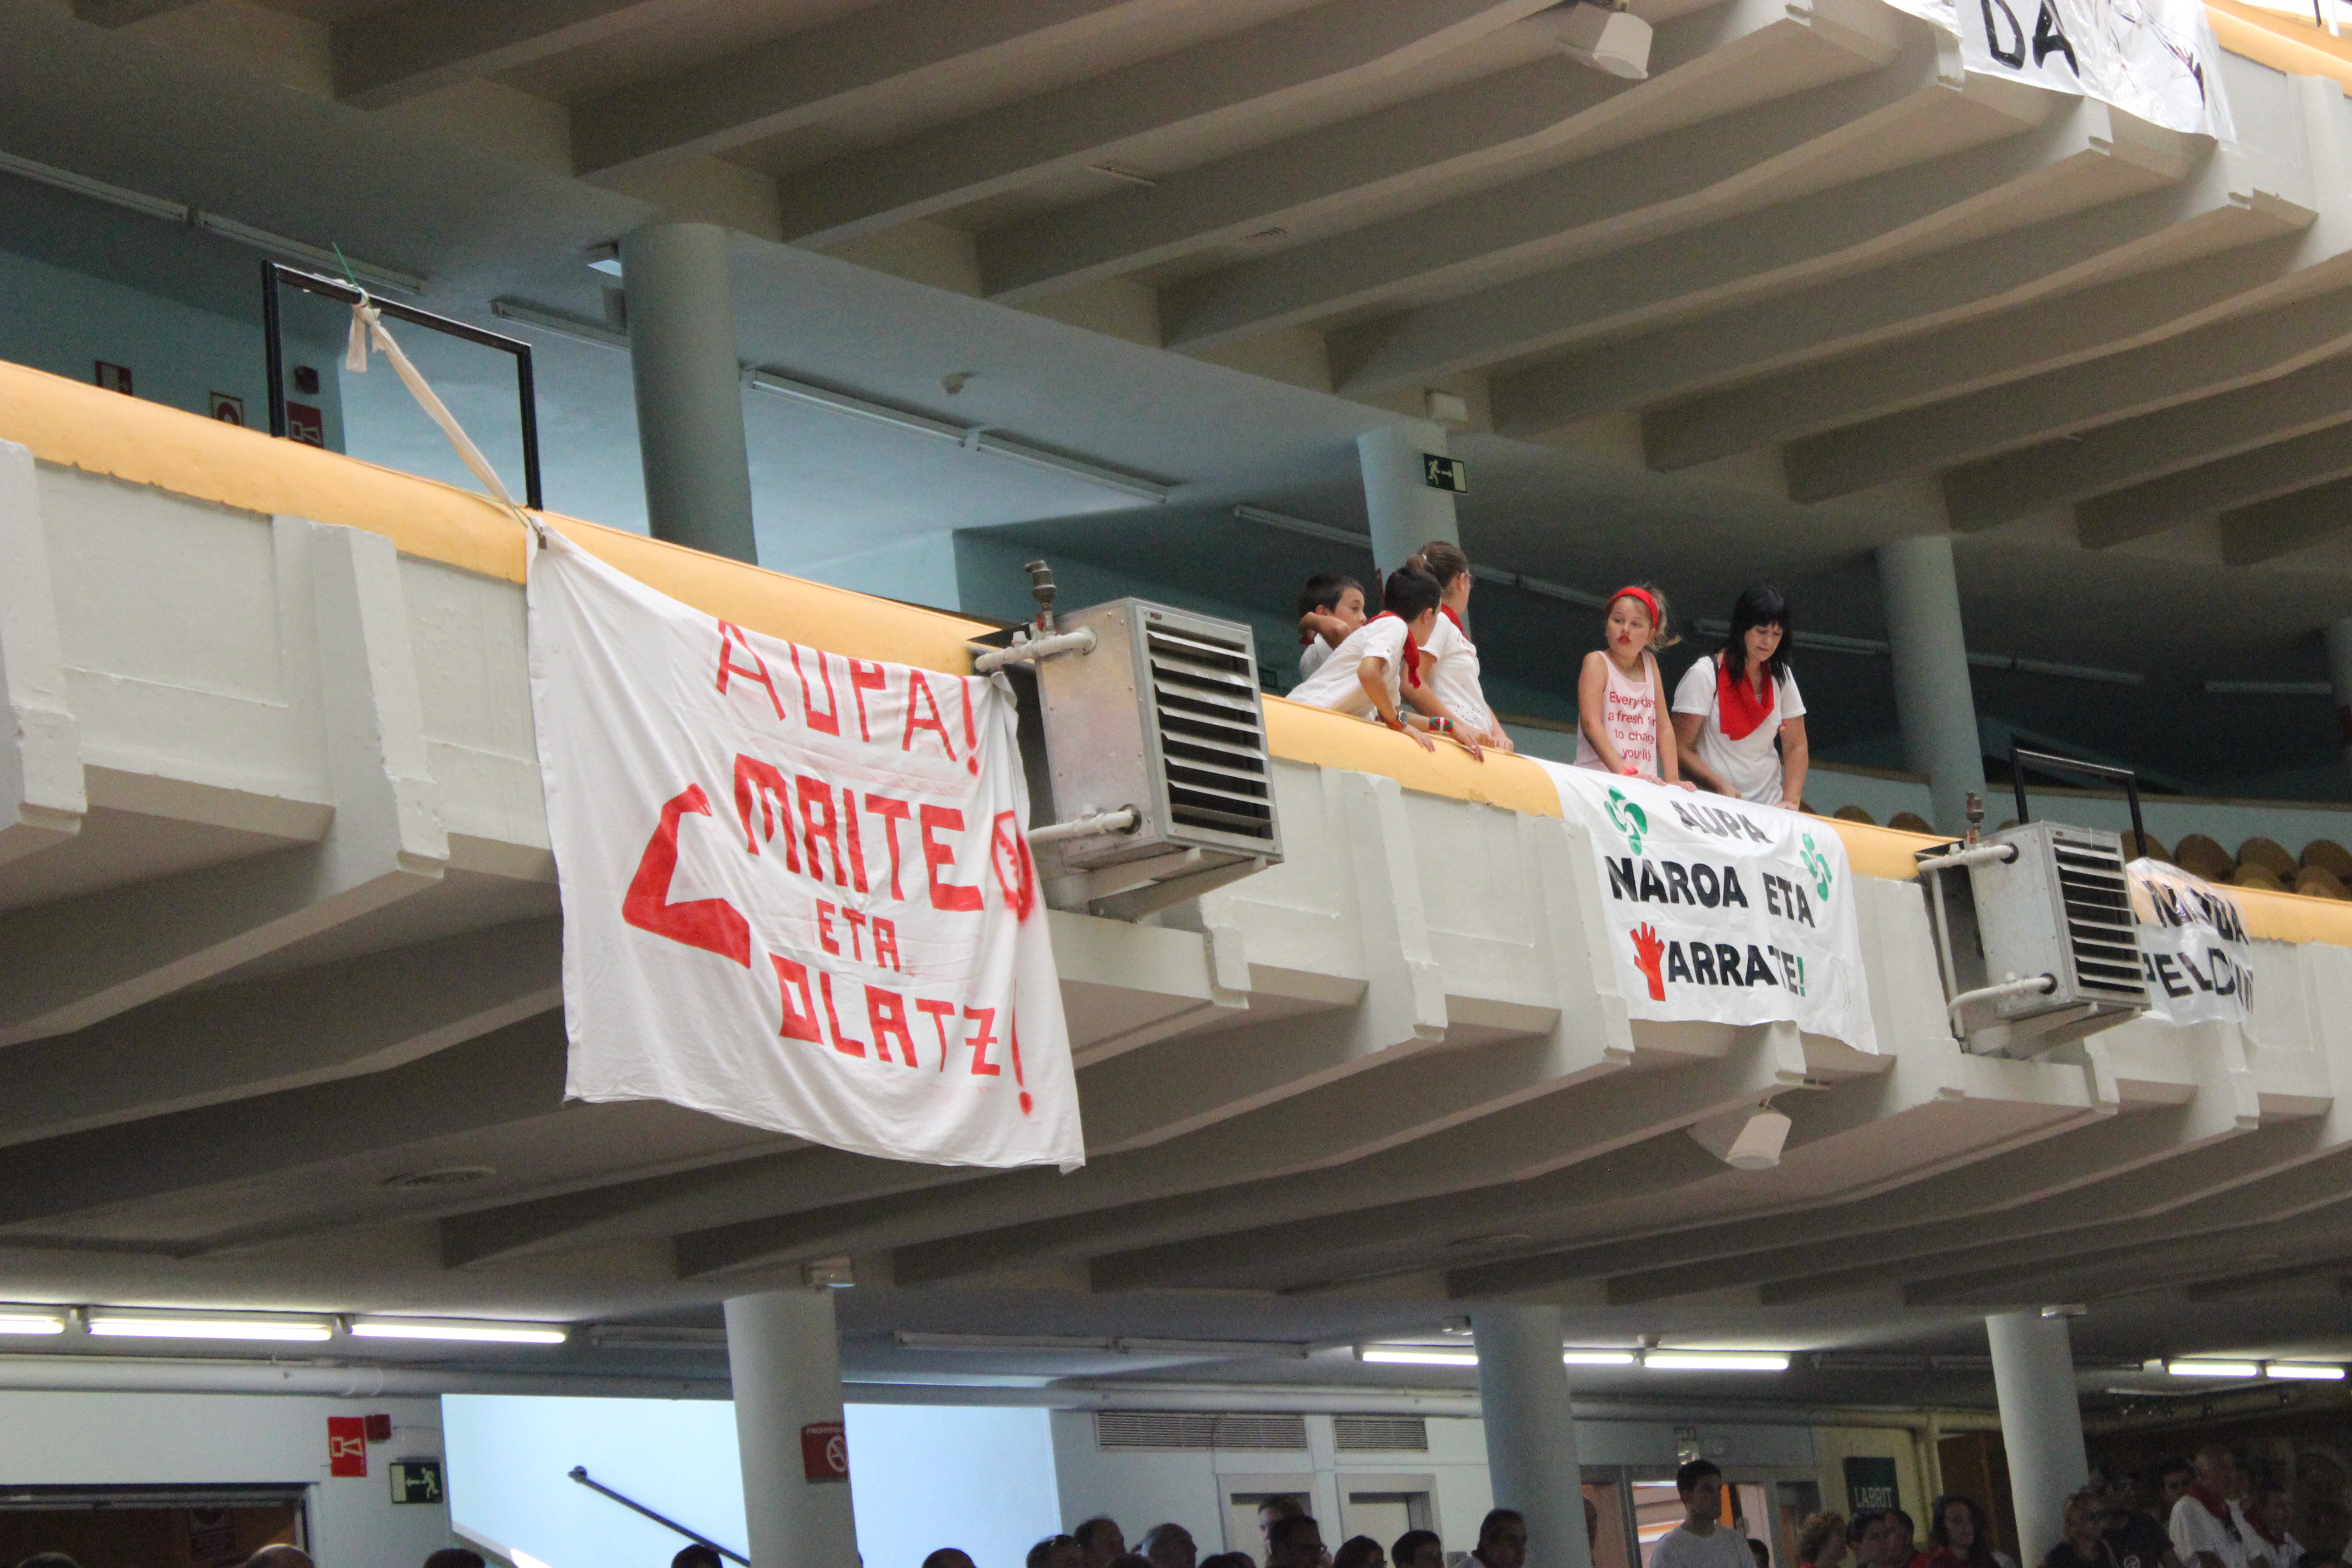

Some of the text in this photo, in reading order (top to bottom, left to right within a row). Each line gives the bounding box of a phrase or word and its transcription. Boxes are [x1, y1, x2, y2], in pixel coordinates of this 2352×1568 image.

[715, 619, 978, 778] AUPA!
[1608, 712, 1615, 721] a
[1616, 710, 1644, 725] fresh
[1609, 691, 1640, 709] Every
[1614, 728, 1624, 740] to
[734, 752, 984, 912] MAITE
[1670, 799, 1776, 844] AUPA
[1603, 855, 1816, 929] NAROA ETA
[815, 897, 901, 972] ETA
[1668, 941, 1806, 998] ARRATE!
[1854, 1486, 1892, 1508] LABRIT
